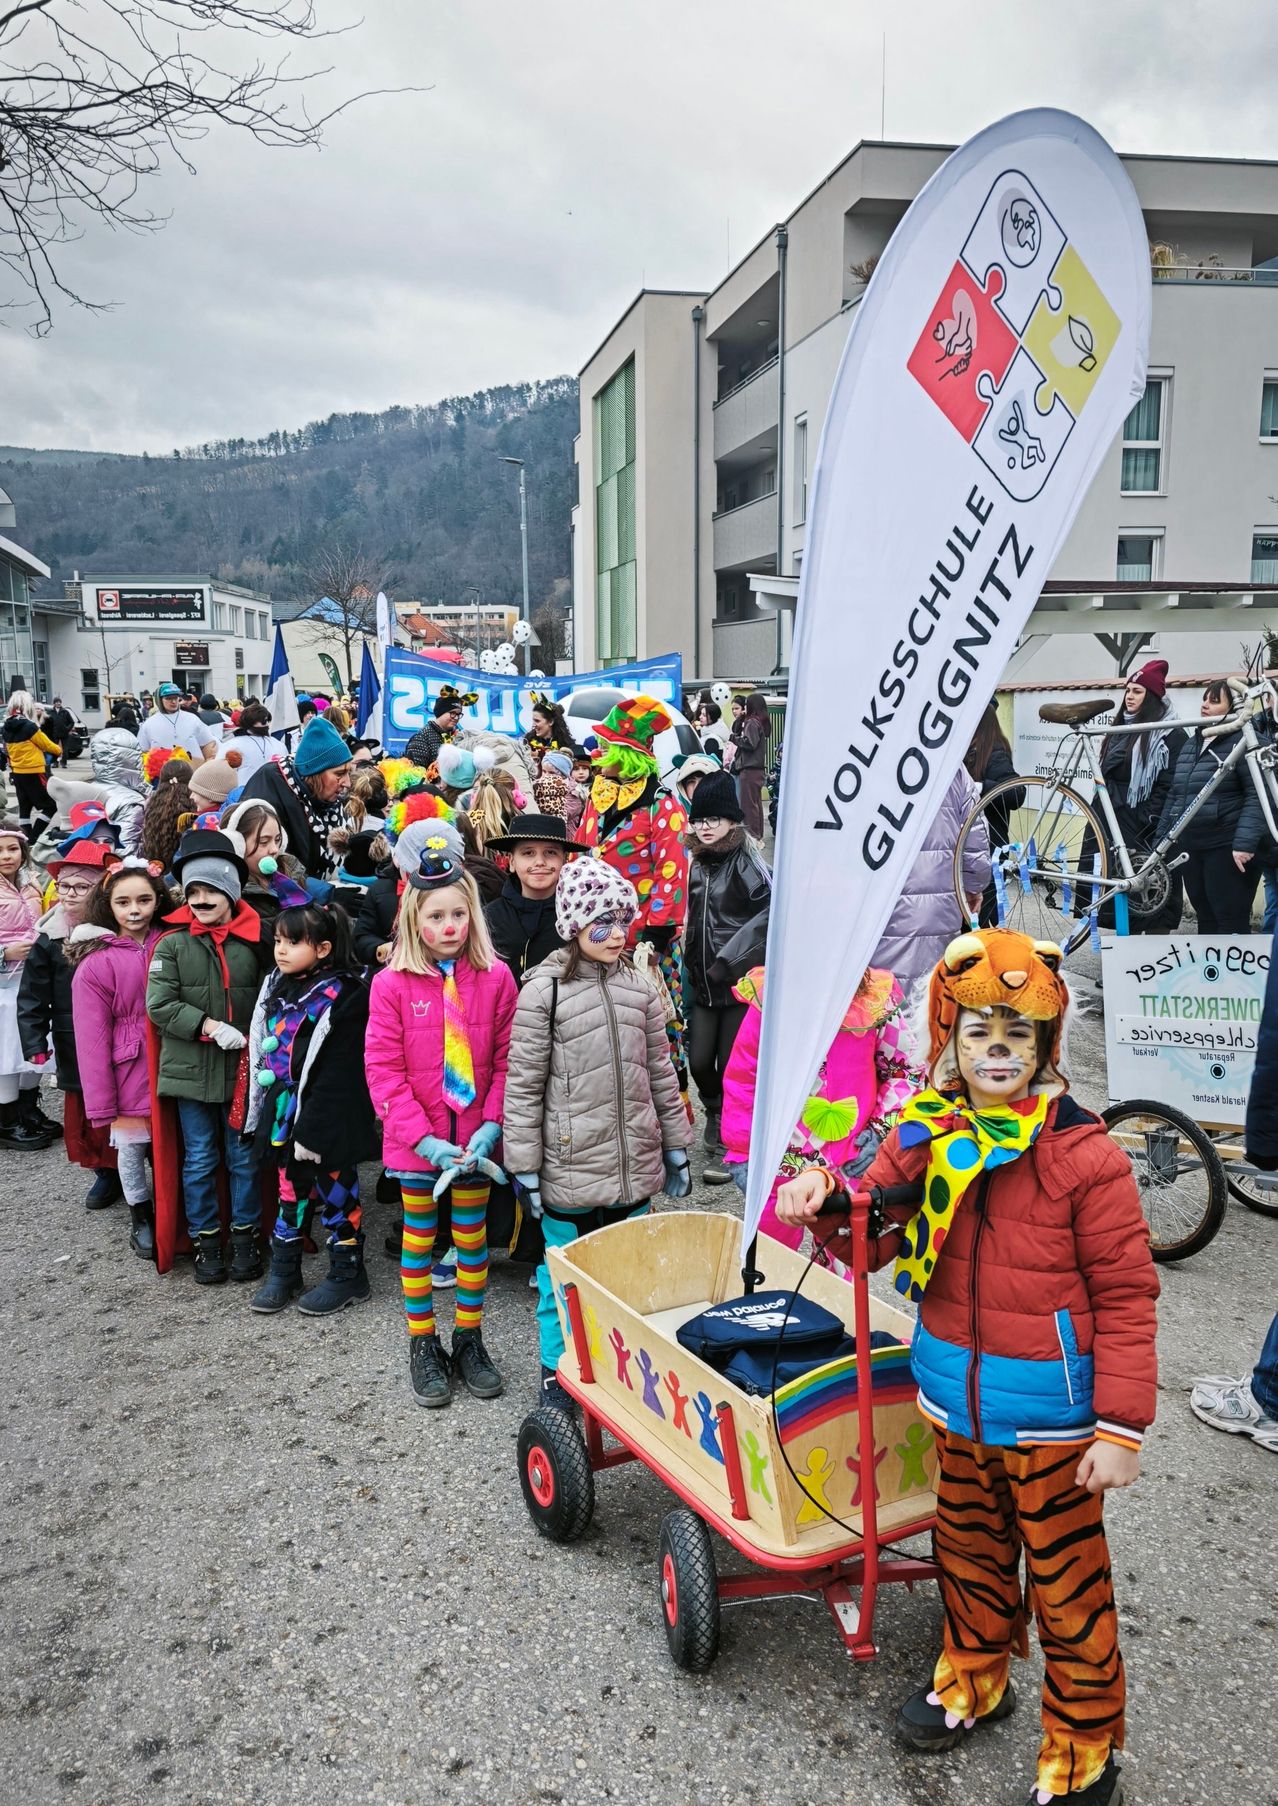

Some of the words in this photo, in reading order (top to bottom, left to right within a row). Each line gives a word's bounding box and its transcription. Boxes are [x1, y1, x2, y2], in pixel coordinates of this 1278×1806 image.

[813, 484, 994, 831] VOLKSSCHULE
[862, 522, 1034, 871] GLOGGNITZ
[1256, 538, 1276, 548] HAPP
